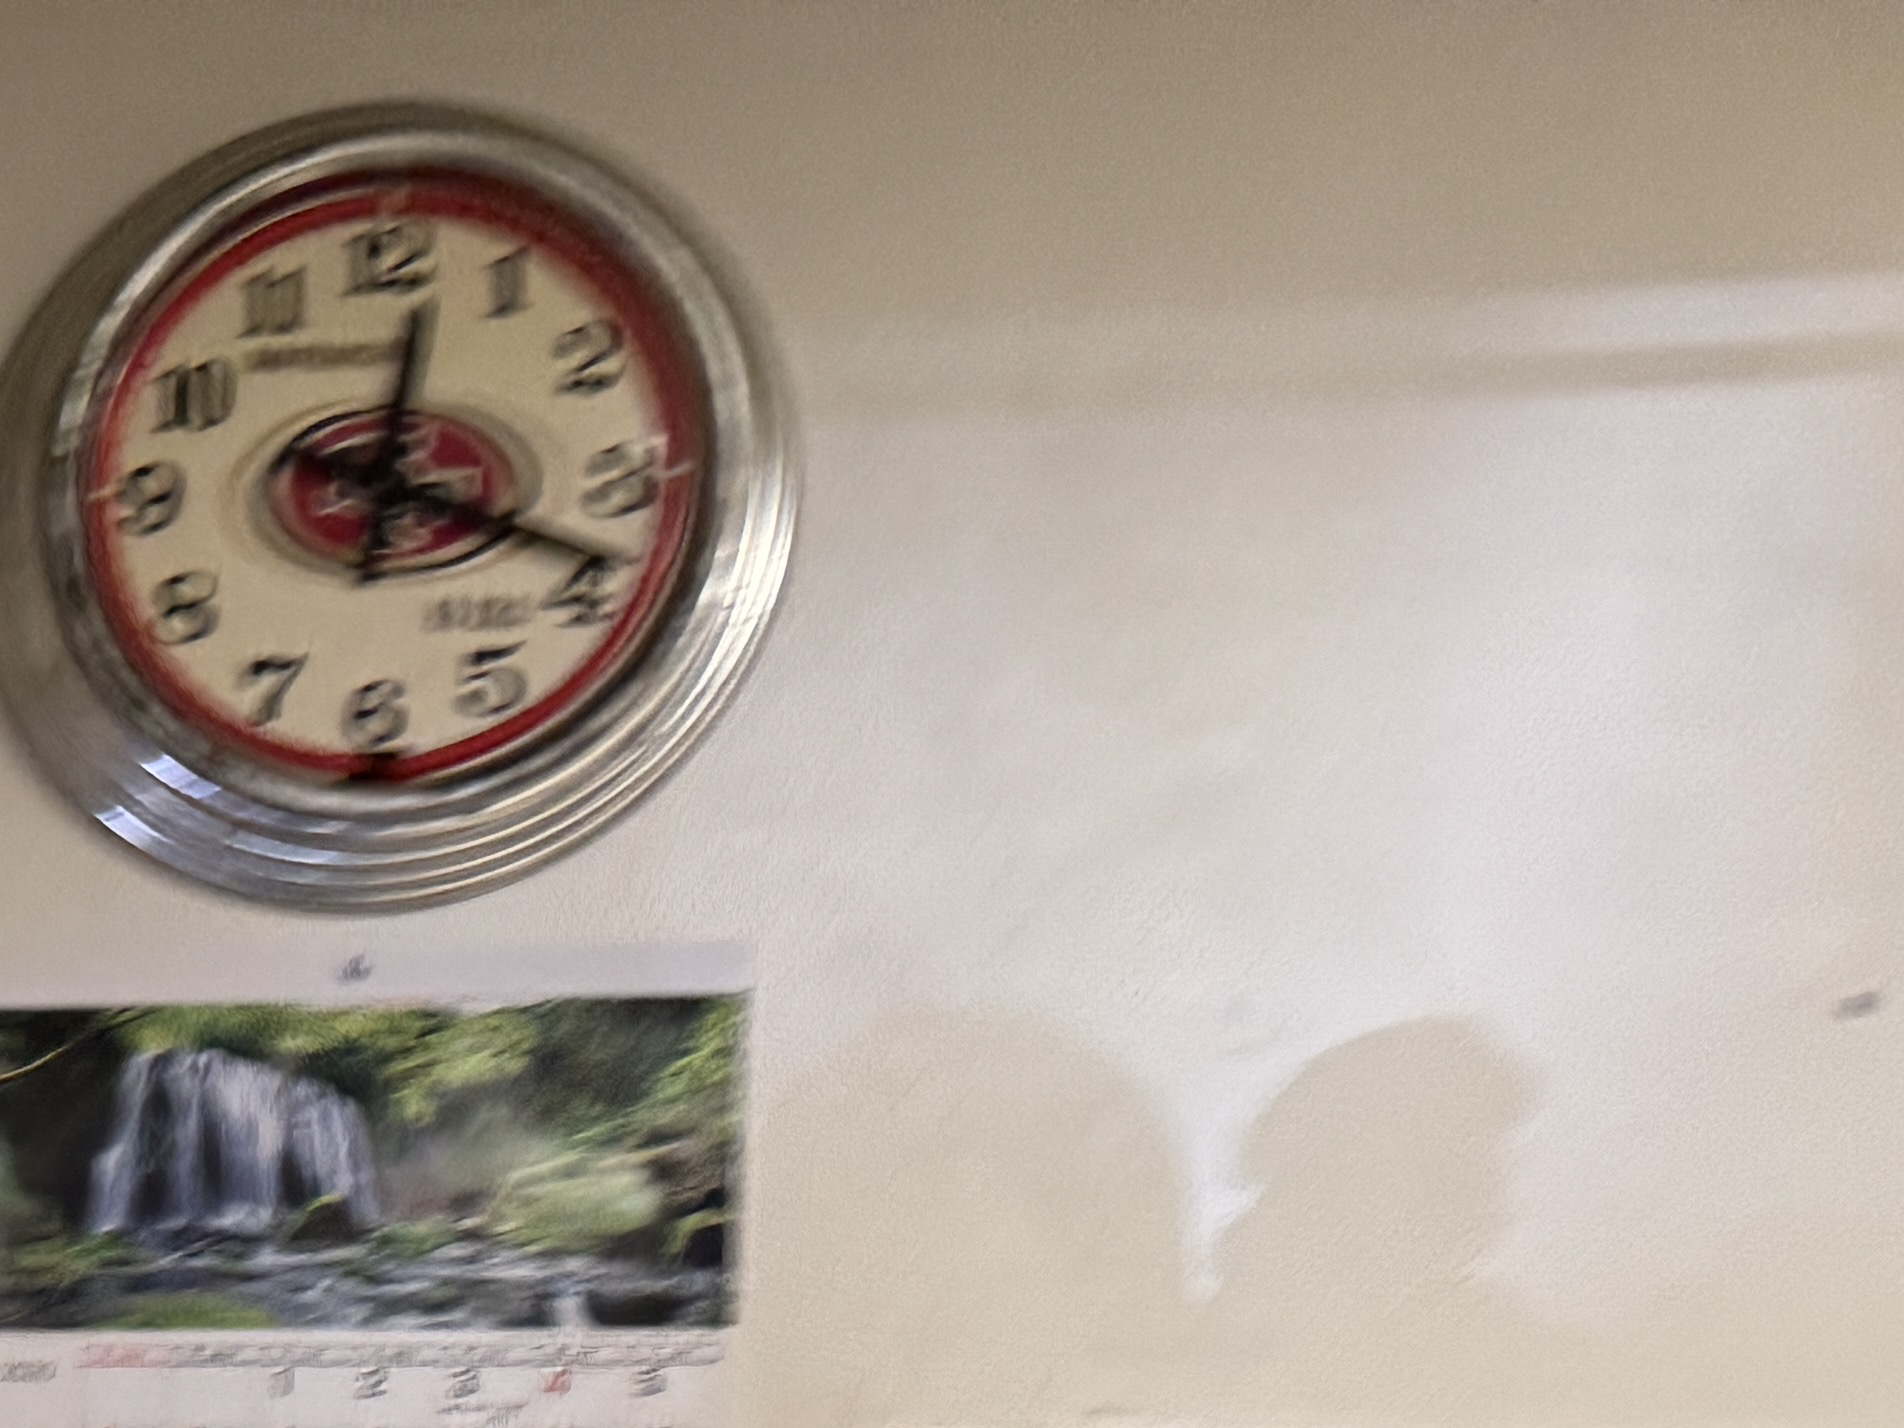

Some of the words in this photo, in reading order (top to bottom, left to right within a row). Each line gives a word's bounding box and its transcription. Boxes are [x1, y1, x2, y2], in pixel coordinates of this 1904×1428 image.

[346, 223, 432, 294] 12
[483, 247, 528, 318] 1
[240, 268, 305, 338] 11
[553, 319, 624, 394] 2
[153, 358, 236, 433] 10
[118, 462, 186, 535] 9
[583, 442, 657, 518] 3
[153, 570, 219, 644] 8
[236, 652, 309, 725] 7
[345, 679, 408, 747] 6
[453, 641, 526, 719] 5
